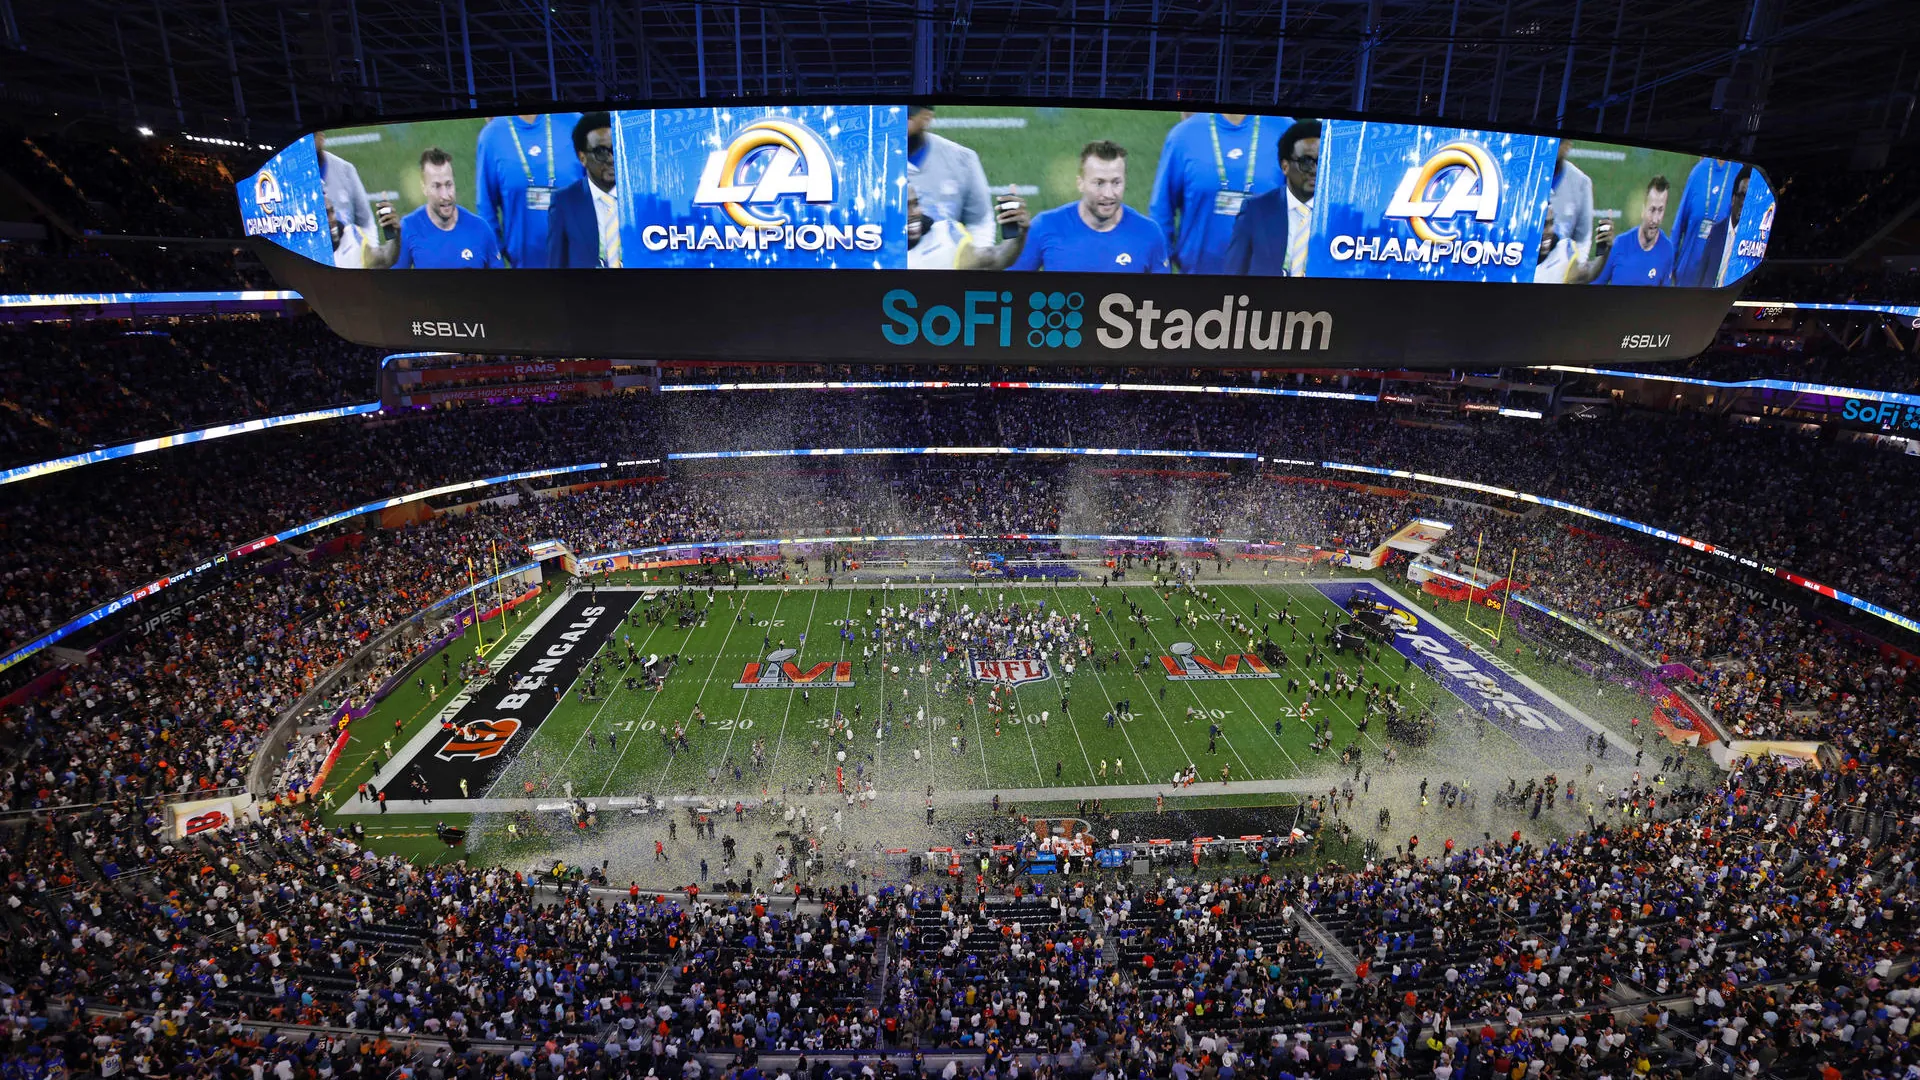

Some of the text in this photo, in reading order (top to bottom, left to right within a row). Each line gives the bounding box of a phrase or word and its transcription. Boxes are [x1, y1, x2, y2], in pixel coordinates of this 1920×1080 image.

[246, 213, 319, 236] CHAMPIONS
[641, 224, 884, 251] CHAMPIONS
[1329, 235, 1525, 267] CHAMPIONS
[882, 289, 1333, 350] SoFi Stadium
[412, 322, 485, 338] #SBLVI
[1621, 335, 1671, 349] #SBLVI
[515, 363, 556, 374] RAMS
[478, 388, 514, 397] HOUSE?
[517, 386, 542, 394] RAMS
[1298, 390, 1356, 400] CHAMPIONS
[1842, 399, 1900, 426] SoFi
[1764, 566, 1775, 574] 40
[171, 573, 185, 583] QTR
[504, 645, 520, 654] OF
[515, 633, 532, 643] US
[495, 605, 606, 711] BENGALS
[977, 660, 1041, 681] NFL
[1396, 632, 1564, 732] RAMS
[1008, 713, 1041, 725] 50
[1192, 709, 1226, 720] 30
[621, 720, 656, 731] 10
[714, 719, 754, 731] 20
